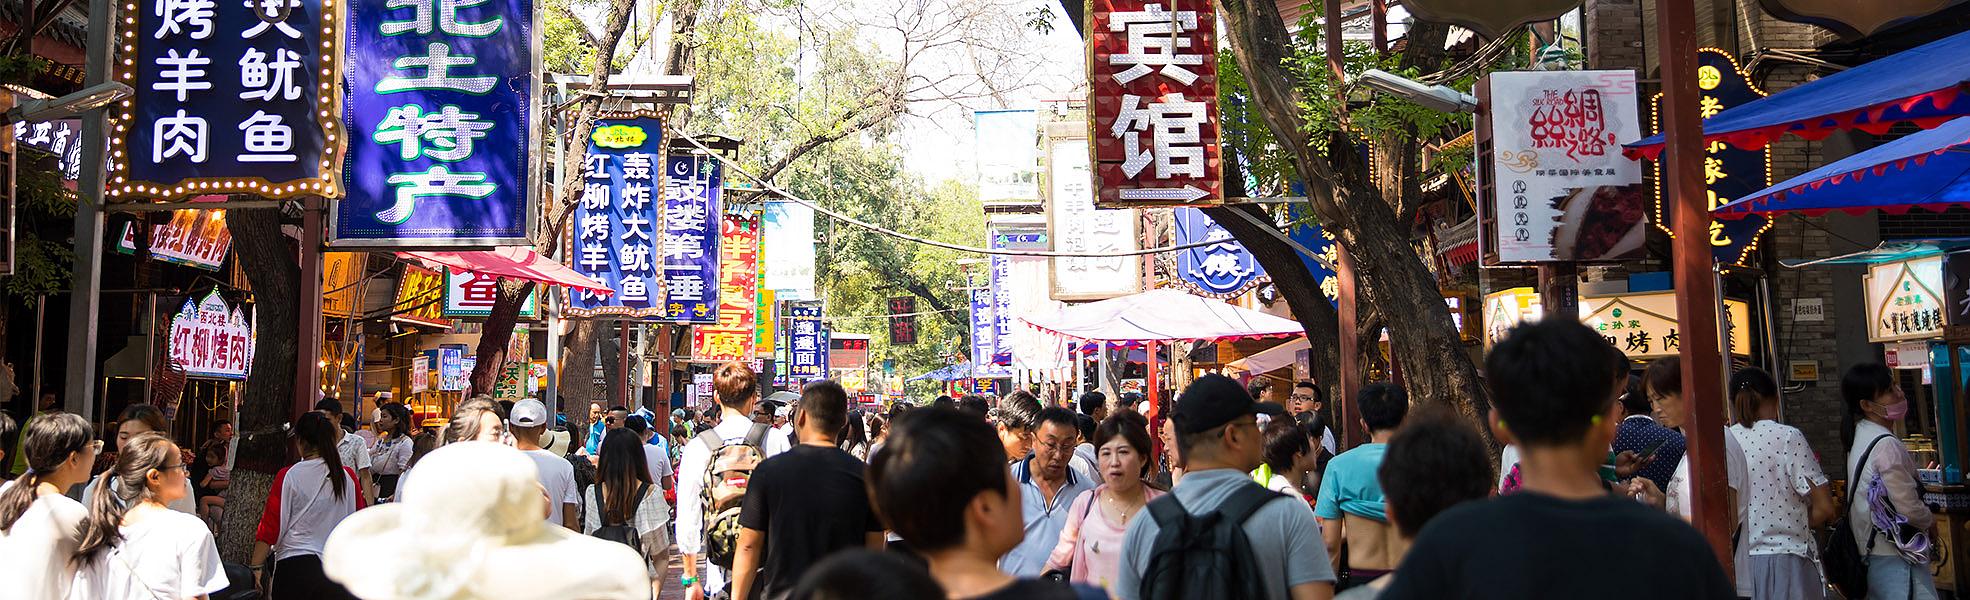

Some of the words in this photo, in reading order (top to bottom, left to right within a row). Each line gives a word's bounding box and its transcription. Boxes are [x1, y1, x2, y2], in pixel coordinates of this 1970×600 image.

[1109, 4, 1208, 180] 宾馆
[620, 152, 651, 301] 轰炸大鱿鱼
[173, 324, 246, 370] 红柳烤肉
